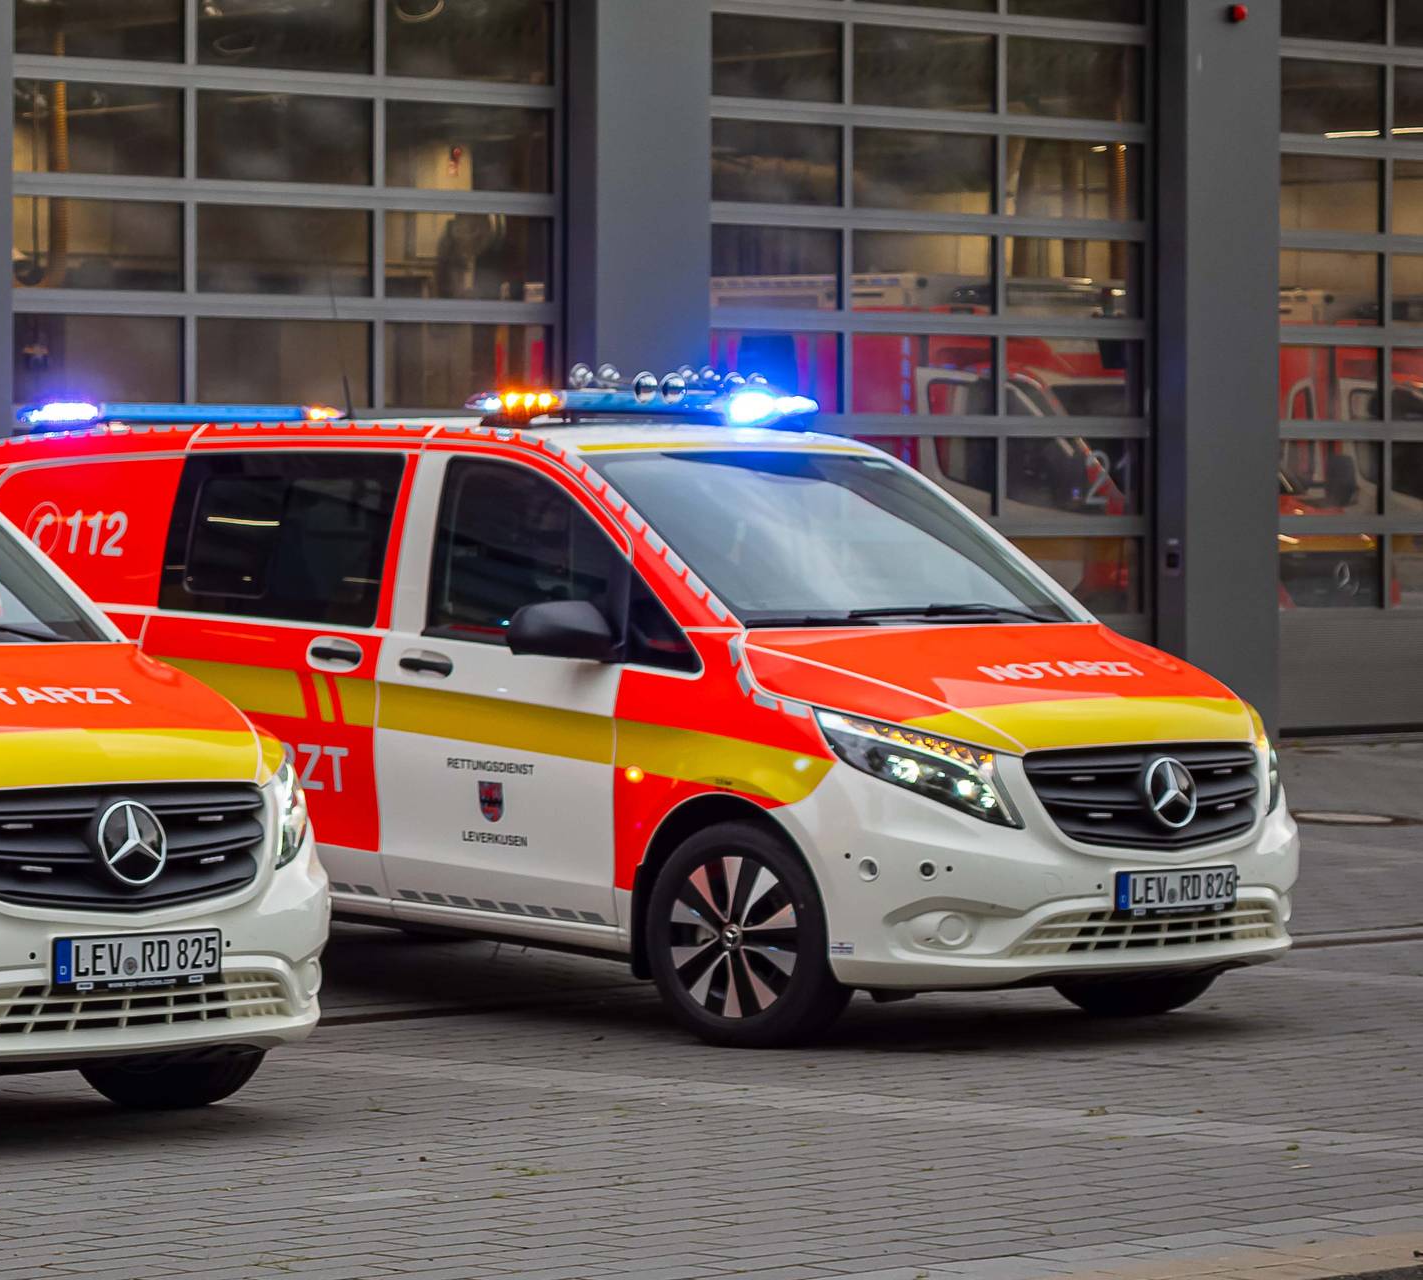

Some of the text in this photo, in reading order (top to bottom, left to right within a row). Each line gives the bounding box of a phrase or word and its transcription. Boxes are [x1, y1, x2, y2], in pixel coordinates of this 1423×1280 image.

[66, 509, 129, 557] 112
[977, 660, 1145, 682] NOTARZT
[446, 757, 535, 776] RETTUNGSDIENST
[461, 829, 528, 847] LEVERKUSEN
[1131, 876, 1168, 904] LEV
[1180, 873, 1202, 901] RD
[1205, 870, 1234, 899] 826
[74, 942, 123, 977] LEV
[141, 939, 170, 973] RD
[176, 936, 217, 970] 825
